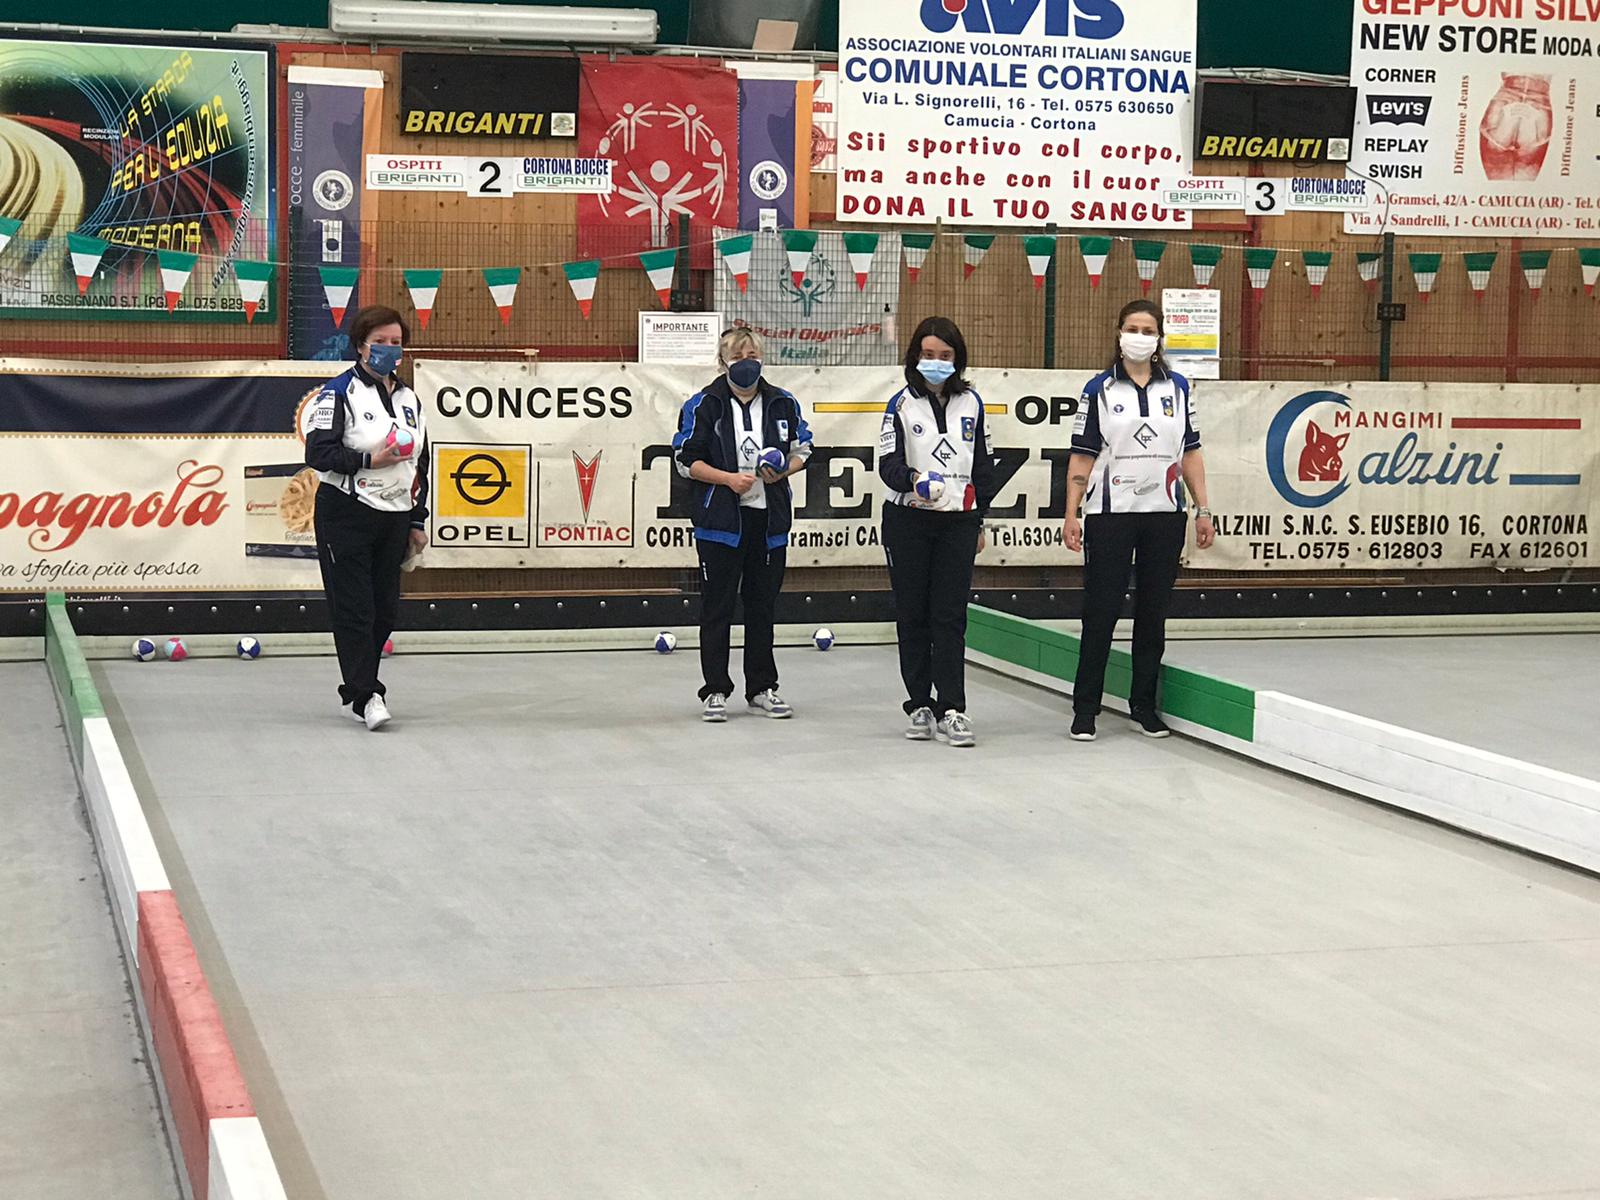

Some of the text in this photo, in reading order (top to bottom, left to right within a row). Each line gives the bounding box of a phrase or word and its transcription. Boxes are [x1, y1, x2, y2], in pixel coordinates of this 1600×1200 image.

[1362, 0, 1522, 18] GEPPONI
[1360, 23, 1430, 51] NEW
[1438, 25, 1538, 54] STORE
[1543, 36, 1593, 57] MODA
[846, 37, 1192, 64] ASSOCIAZIONE VOLONTARI ITALIANI SANGUE
[845, 57, 1191, 95] COMUNALE CORTONA
[1365, 68, 1436, 83] CORNER
[120, 51, 194, 137] LA STRADA
[863, 91, 888, 106] Via
[894, 93, 909, 106] L.
[914, 93, 1001, 111] Signorelli,
[1008, 98, 1026, 111] 16
[1041, 98, 1069, 112] Tel.
[1075, 99, 1113, 113] 0575
[1118, 100, 1175, 115] 630650
[290, 90, 304, 152] femminile
[405, 110, 544, 135] BRIGANTI
[944, 114, 1015, 129] Camucia
[1030, 115, 1097, 131] Cortona
[1453, 75, 1470, 175] Diffusione Jeans
[1561, 78, 1577, 177] Diffusione Jeans
[847, 131, 1182, 165] Sii sportivo col corpo,
[1202, 135, 1322, 159] BRIGANTI
[1364, 138, 1429, 153] REPLAY
[387, 159, 442, 170] OSPITI
[523, 158, 609, 176] CORTONA BOCCE
[1368, 164, 1423, 179] SWISH
[290, 166, 303, 205] occe
[378, 174, 457, 184] BRIGANTI
[478, 161, 502, 193] 2
[524, 175, 602, 187] BRIGANTI
[844, 166, 1160, 191] ma anche con il cuor
[1178, 179, 1224, 189] OSPITI
[1291, 177, 1366, 195] CORTONA BOCCE
[1170, 192, 1237, 202] BRIGANTI
[1254, 181, 1276, 211] 3
[1295, 194, 1363, 205] BRIGANTI
[1373, 193, 1385, 204] A.
[1389, 193, 1440, 208] Gramsci,
[1443, 194, 1468, 207] 42/A
[1478, 196, 1535, 209] CAMUCIA
[1538, 197, 1564, 210] (AR)
[1575, 198, 1594, 209] Tel.
[842, 195, 1186, 222] DONA IL TUO SANGUE
[1350, 214, 1371, 226] Via
[1390, 214, 1450, 229] Sandrelli,
[1472, 215, 1532, 228] CAMUCIA
[1536, 216, 1563, 230] (AR)
[1574, 217, 1595, 229] Tel.
[41, 294, 117, 307] PASSIGNANO
[194, 297, 216, 309] 075
[221, 297, 266, 310] 8293
[653, 323, 709, 331] IMPORTANTE
[798, 323, 881, 342] Olympics
[437, 386, 633, 418] CONCESS
[1015, 396, 1080, 425] OP
[1335, 411, 1443, 429] MANGIMI
[437, 525, 524, 542] OPEL
[544, 527, 630, 541] PONTIAC
[1212, 514, 1588, 537] ALZINI S.N.C. S. EUSEBIO 16, CORTONA
[646, 527, 695, 548] CORT
[790, 527, 850, 548] ramsci
[1368, 542, 1443, 559] 612803
[1469, 542, 1510, 559] FAX
[1519, 541, 1588, 559] 612601
[22, 558, 90, 582] sfoglia
[93, 560, 130, 581] più
[134, 561, 201, 581] spessa
